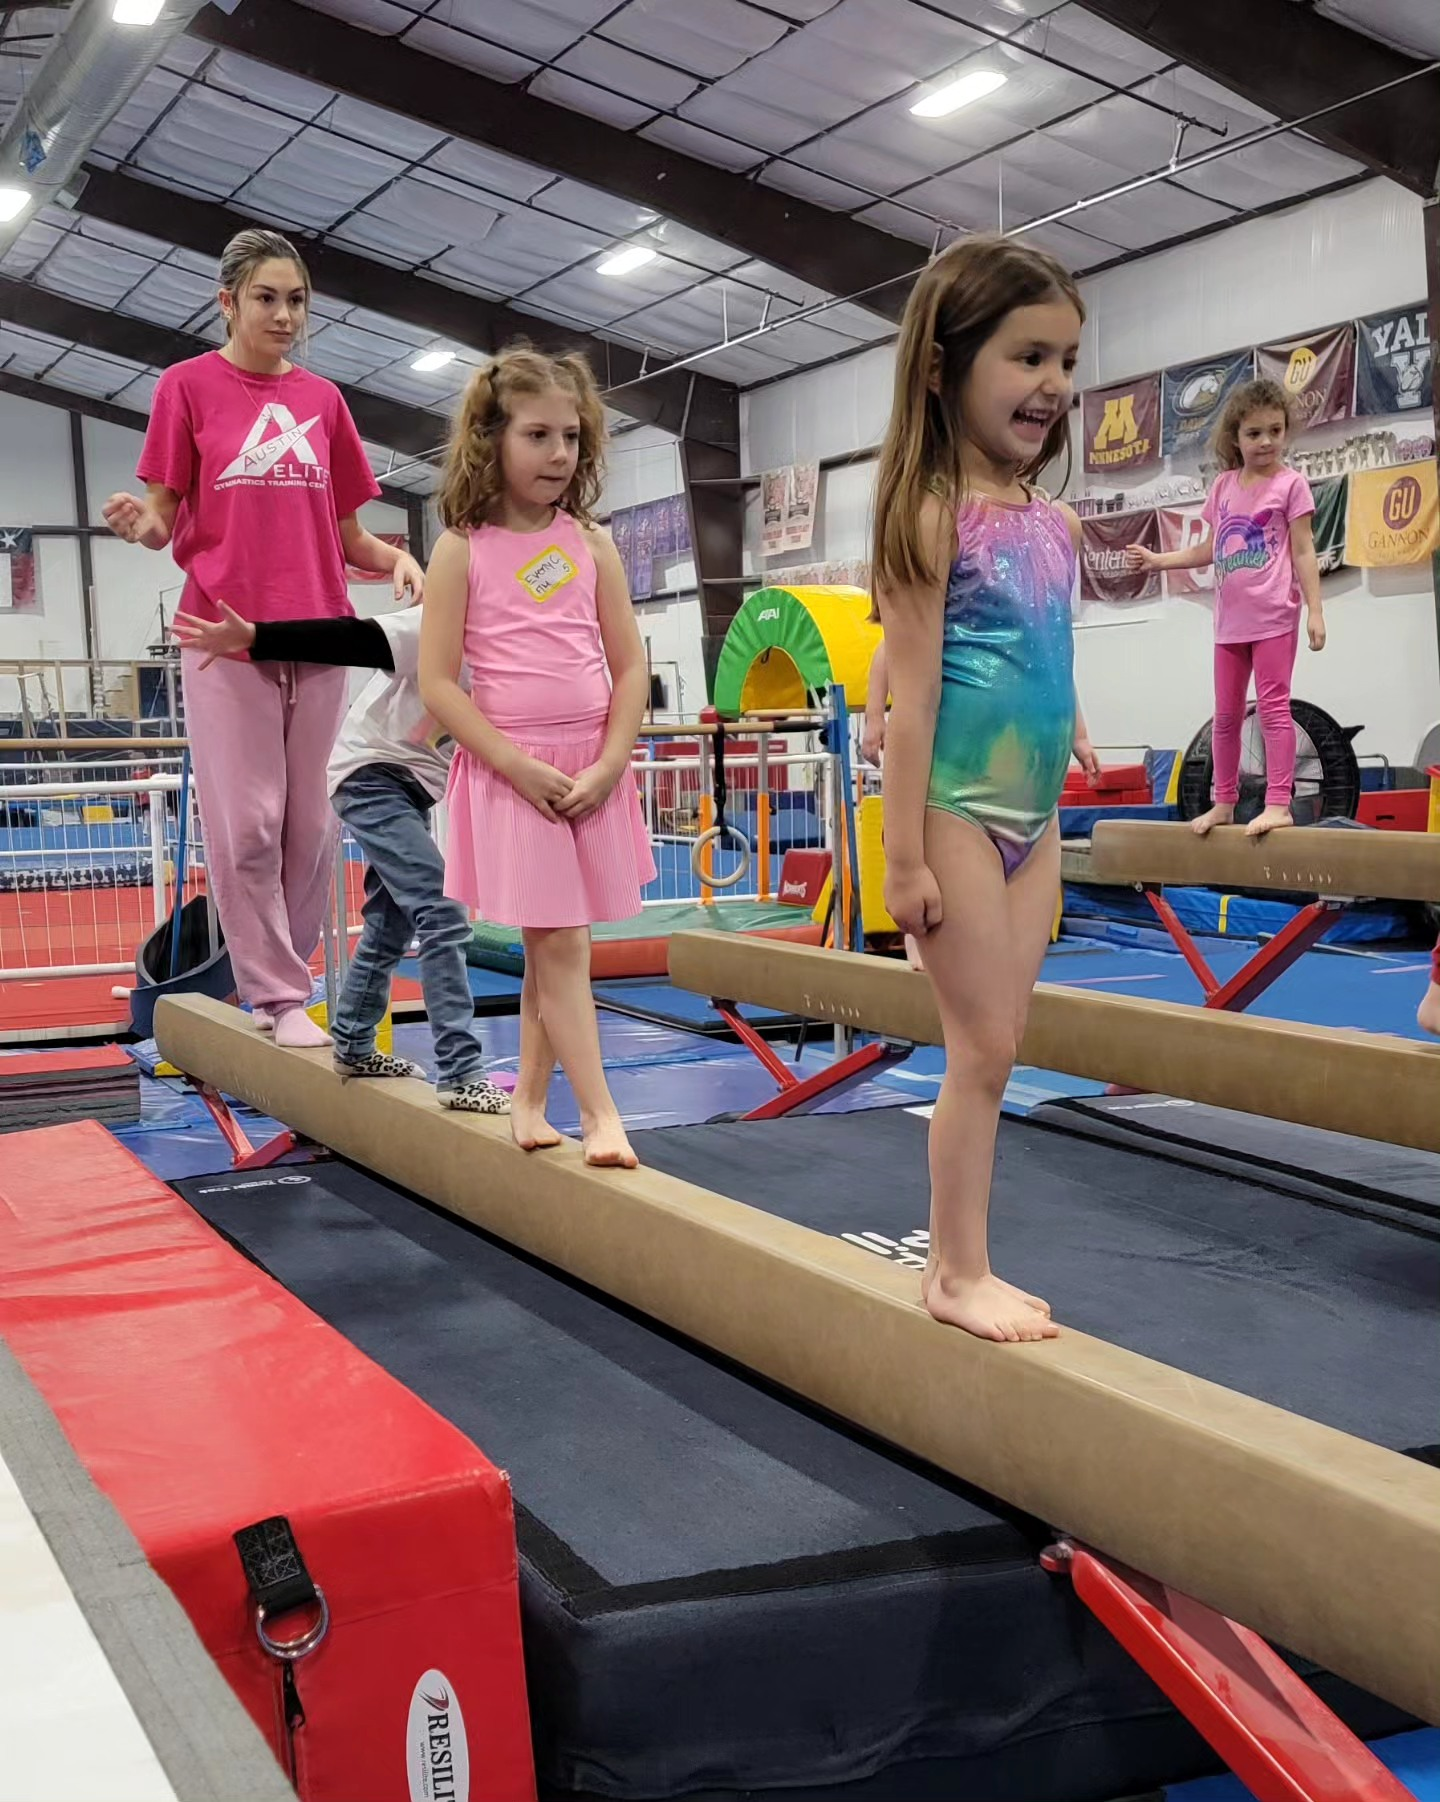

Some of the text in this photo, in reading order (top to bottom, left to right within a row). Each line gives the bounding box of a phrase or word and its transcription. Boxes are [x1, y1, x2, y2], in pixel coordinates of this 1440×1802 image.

[1371, 312, 1431, 358] YAL
[243, 427, 302, 472] AUSTIN
[213, 478, 266, 491] GYMNASTICS
[267, 479, 307, 487] TRAINING
[1389, 486, 1416, 521] GU
[1368, 527, 1430, 550] GANNON
